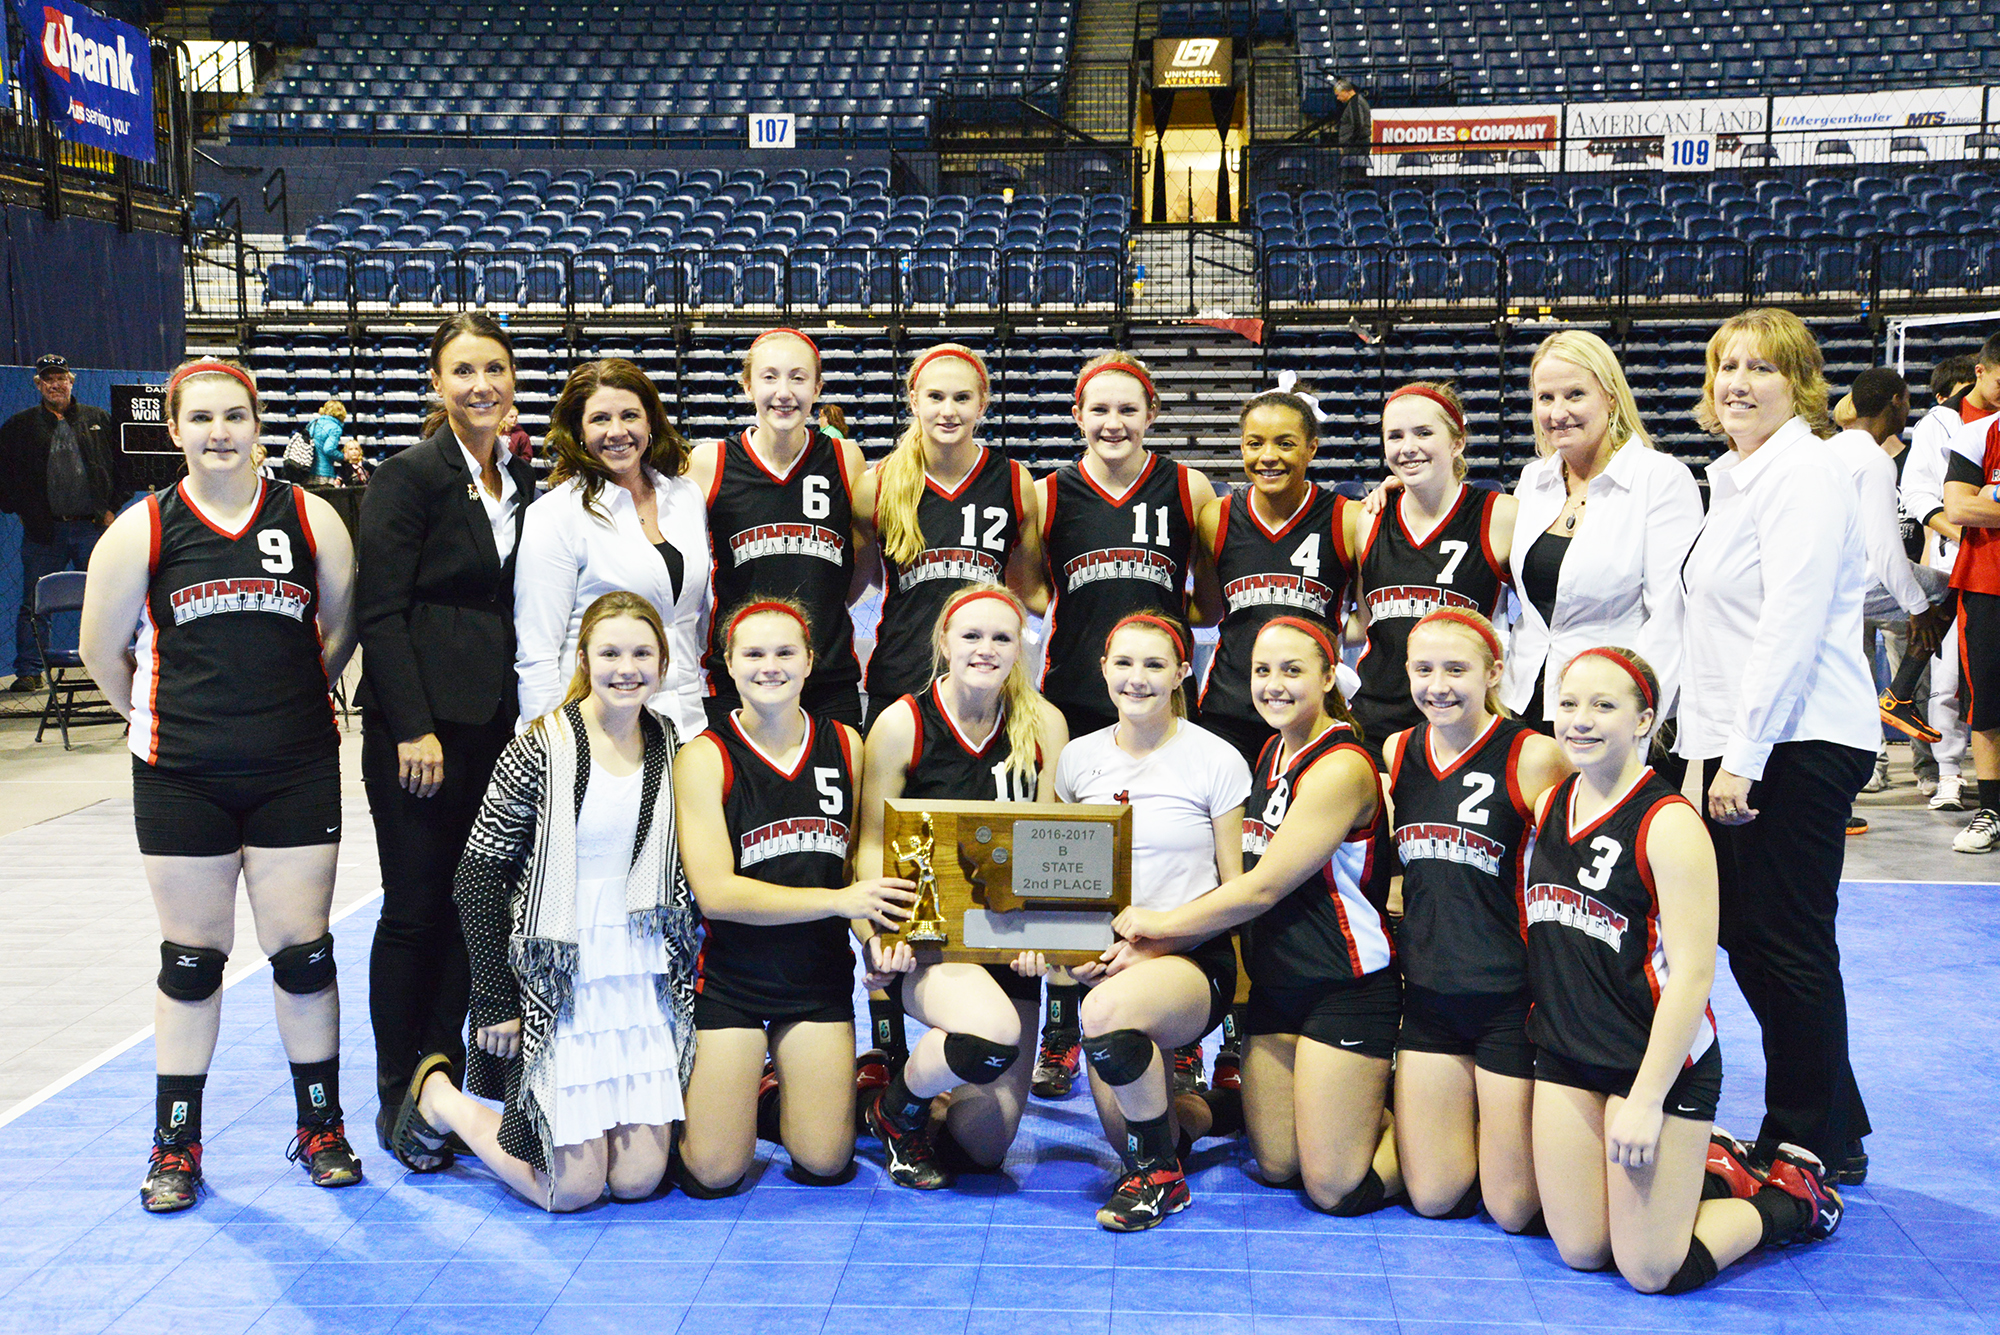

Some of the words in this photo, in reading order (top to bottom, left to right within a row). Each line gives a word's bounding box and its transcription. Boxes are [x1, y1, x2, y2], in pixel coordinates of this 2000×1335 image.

[1164, 70, 1221, 78] UNIVERSAL
[1165, 77, 1221, 85] ATHLETIC
[756, 119, 788, 142] 107
[1382, 126, 1456, 143] NOODLES
[1470, 123, 1547, 142] COMPANY
[1571, 110, 1692, 136] AMERICAN
[1699, 107, 1763, 133] LAND
[1791, 112, 1893, 128] Mergenthaler
[1905, 111, 1947, 126] MTS
[1671, 139, 1710, 166] 109
[131, 398, 161, 410] SETS
[131, 409, 161, 421] WON
[802, 474, 830, 520] 6
[729, 522, 846, 568] HUNTLEY
[960, 503, 1009, 551] 12
[1132, 502, 1170, 547] 11
[256, 529, 294, 574] 9
[1063, 547, 1177, 594] HUNTLEY
[1290, 533, 1320, 578] 4
[1436, 540, 1469, 584] 7
[169, 577, 312, 627] HUNTLEY
[1224, 572, 1334, 618] HUNTLEY
[814, 766, 844, 815] 5
[1262, 777, 1290, 827] 8
[1457, 771, 1496, 826] 2
[740, 816, 851, 869] HUNTLEY
[1031, 828, 1096, 841] 2016-2017
[1058, 846, 1068, 857] B
[1023, 878, 1049, 890] 2nd
[1053, 879, 1102, 891] PLACE
[1041, 862, 1084, 874] STATE
[1576, 835, 1623, 892] 3
